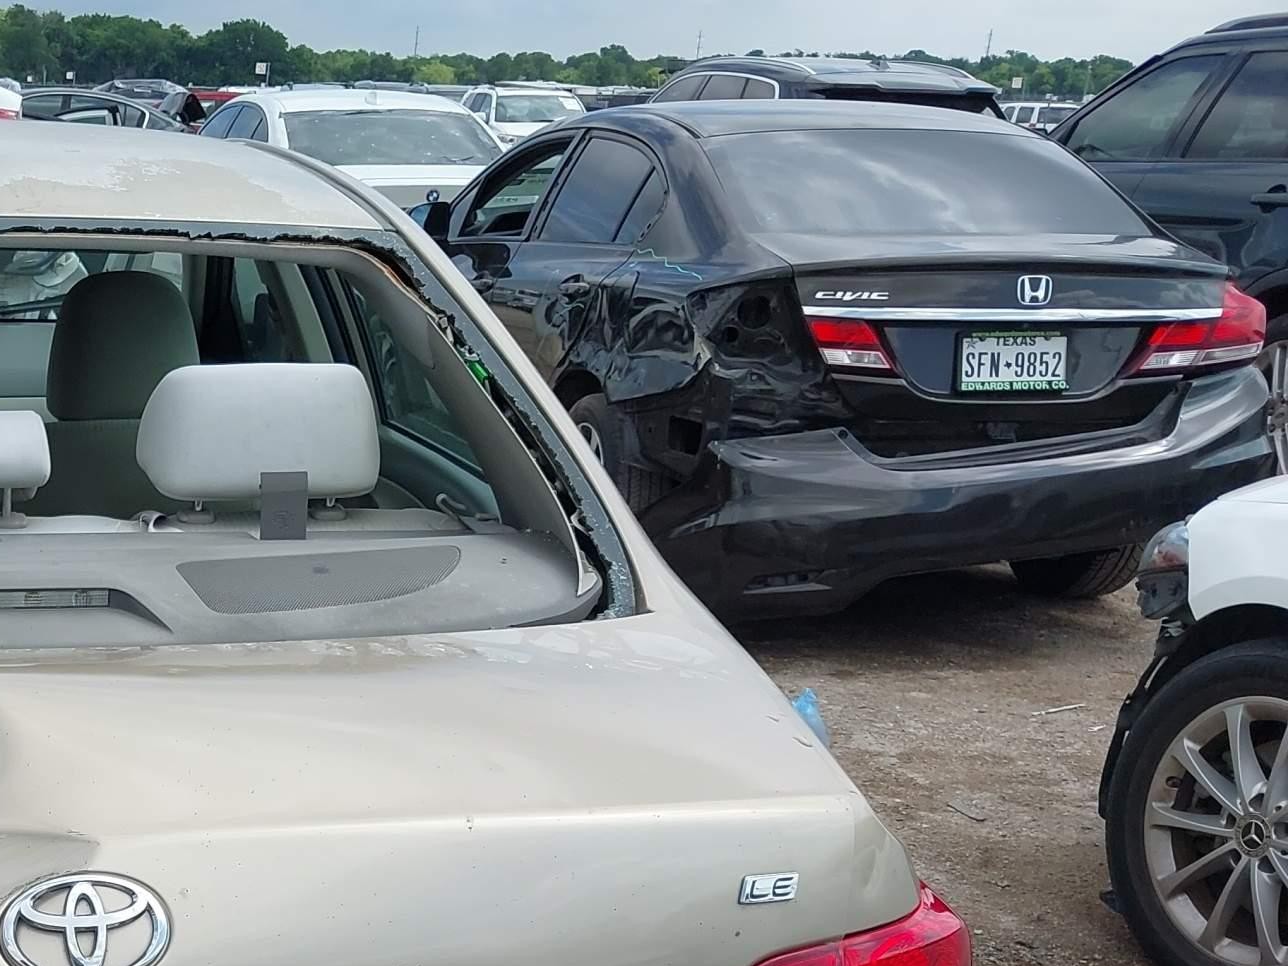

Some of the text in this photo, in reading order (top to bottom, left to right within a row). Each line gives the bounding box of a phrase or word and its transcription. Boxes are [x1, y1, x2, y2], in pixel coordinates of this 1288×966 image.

[815, 290, 889, 301] CIVIC
[996, 335, 1037, 347] TEXAS
[964, 351, 1062, 378] SFN 9852
[961, 380, 1070, 391] EDWARDS MOTOR CO.
[746, 875, 796, 902] LE
